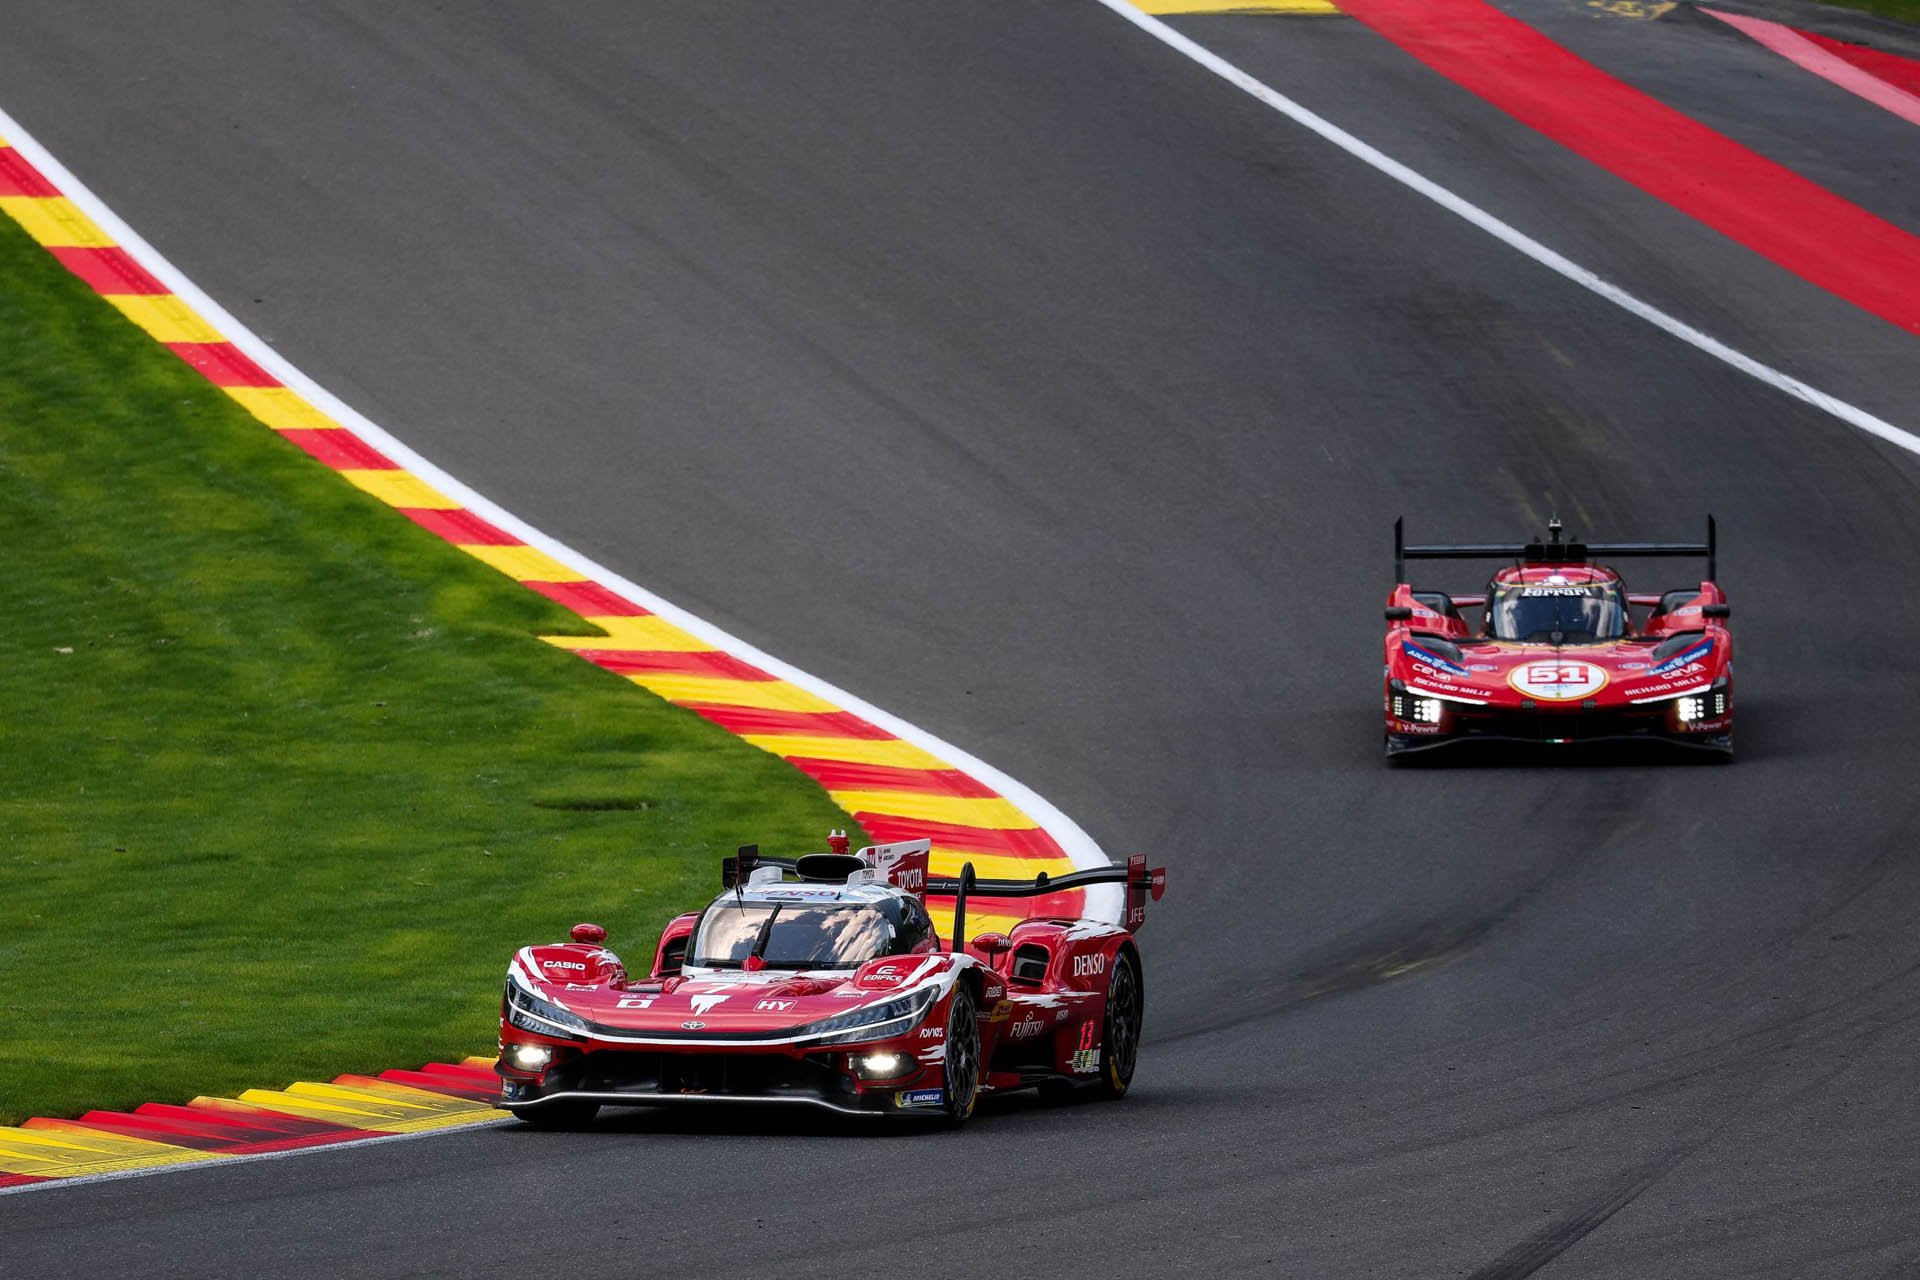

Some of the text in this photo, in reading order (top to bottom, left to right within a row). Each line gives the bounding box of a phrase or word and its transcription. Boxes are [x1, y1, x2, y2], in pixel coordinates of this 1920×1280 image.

[1530, 667, 1586, 683] 51
[1413, 676, 1493, 697] RICHARD MILLE
[1624, 675, 1704, 696] RICHARD MILLE
[1403, 723, 1440, 733] V-Power
[897, 868, 923, 889] TOYOTA
[1129, 907, 1143, 923] JFE
[543, 961, 586, 971] CASIO
[1073, 953, 1105, 977] DENSO
[757, 1001, 794, 1011] HY
[1010, 1019, 1044, 1040] FUJITSU
